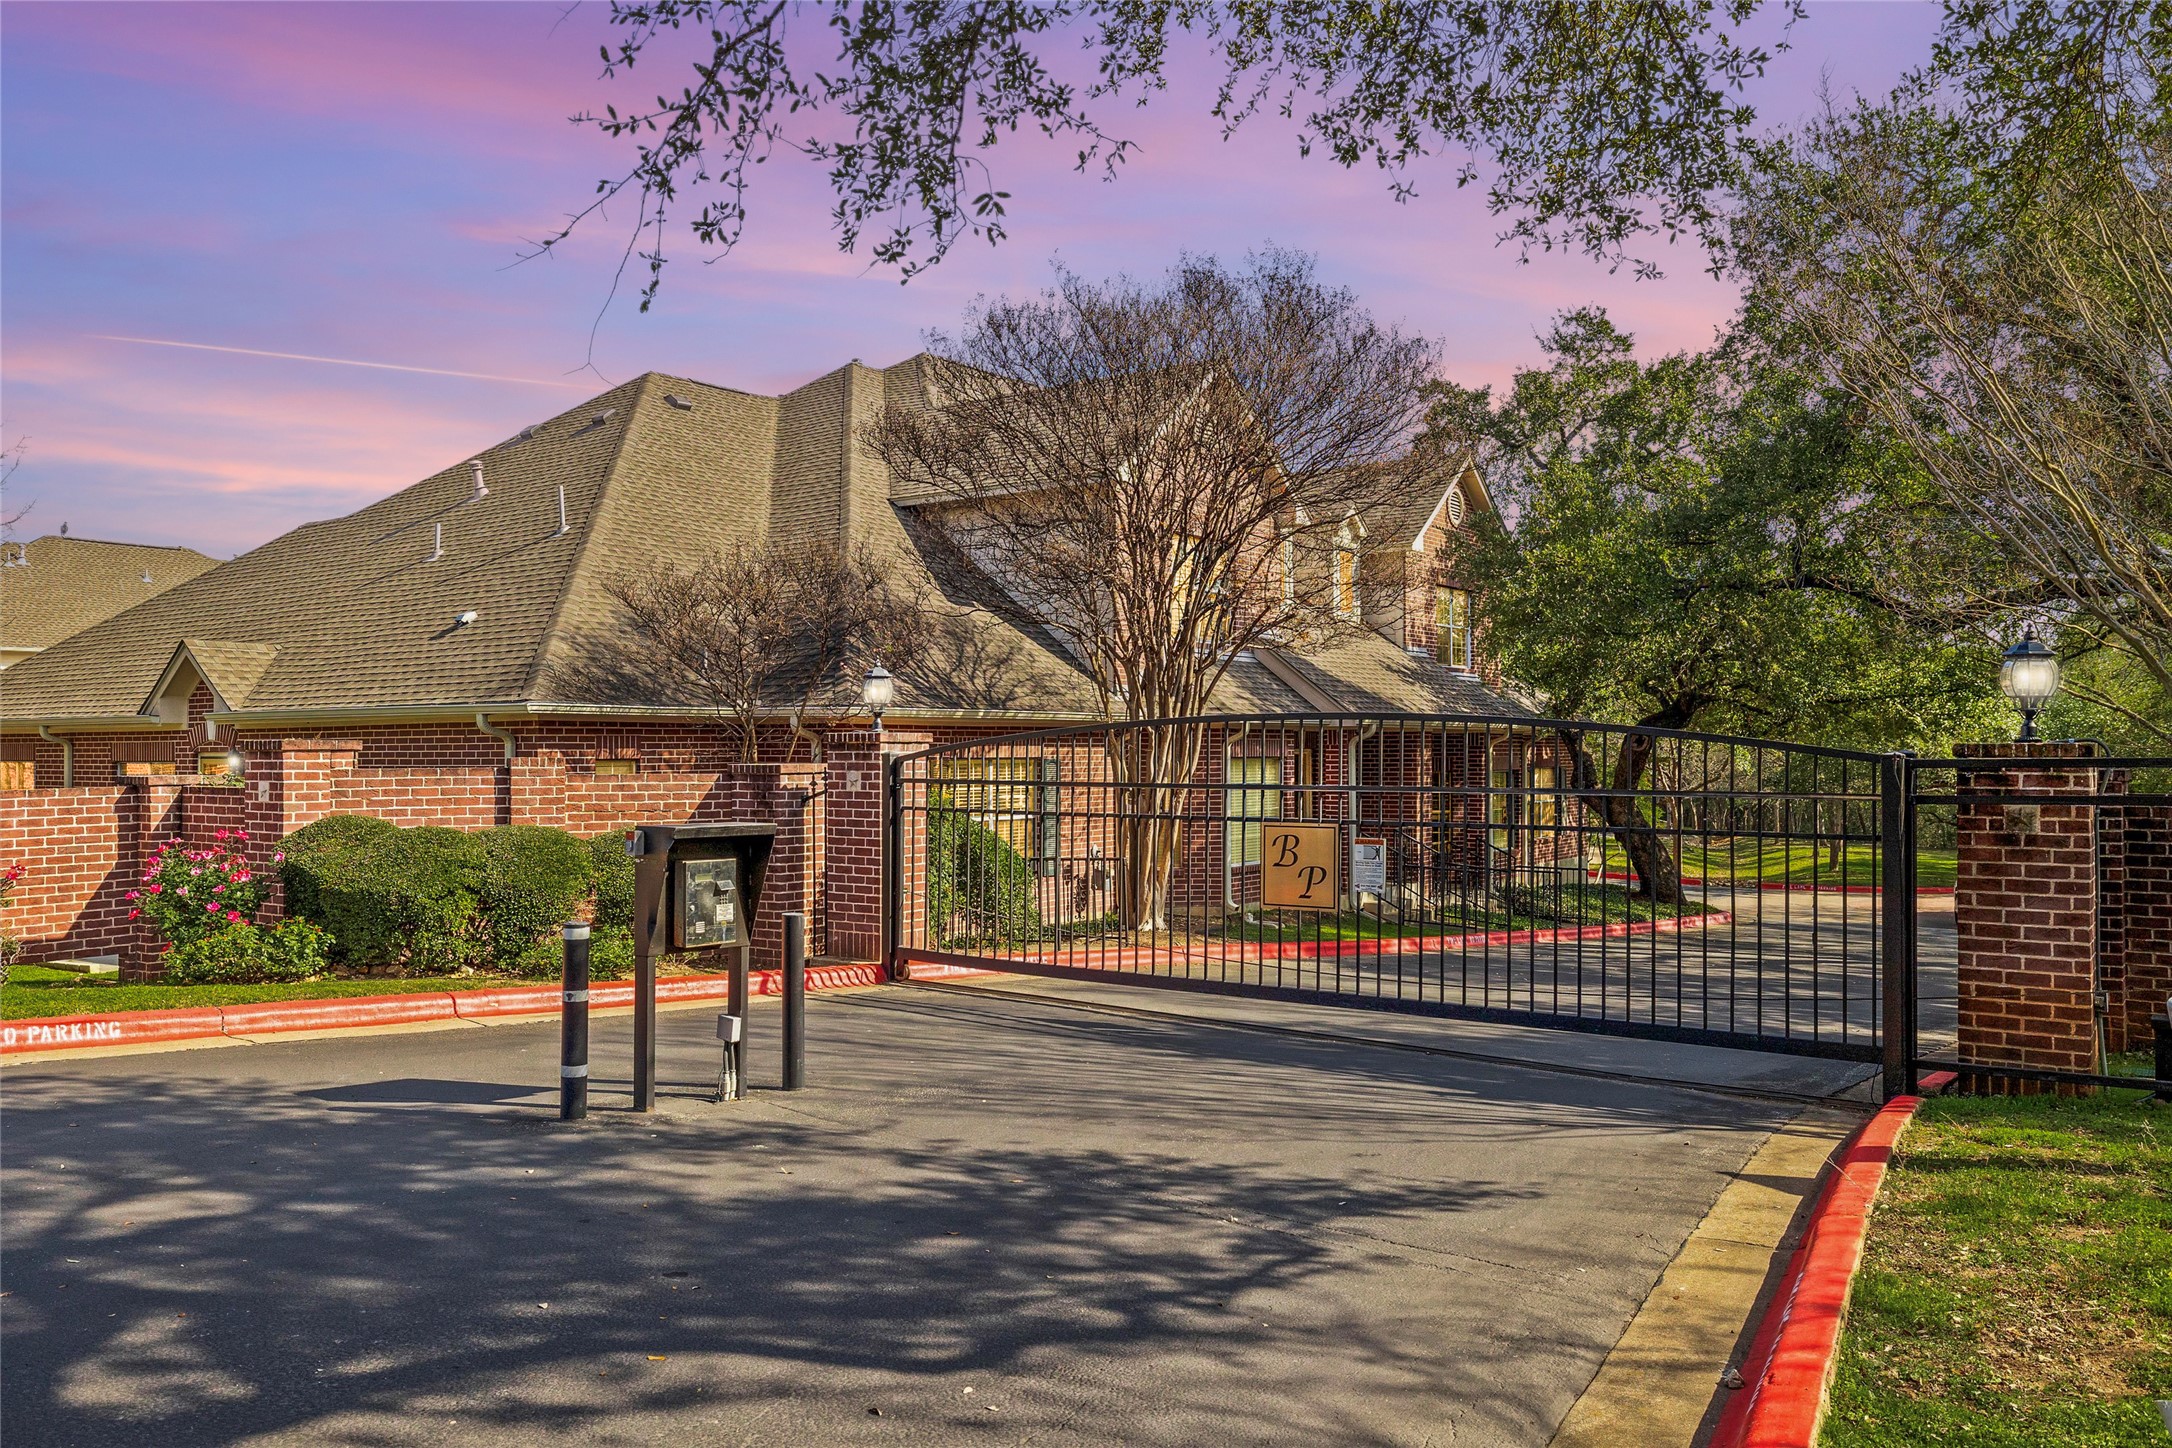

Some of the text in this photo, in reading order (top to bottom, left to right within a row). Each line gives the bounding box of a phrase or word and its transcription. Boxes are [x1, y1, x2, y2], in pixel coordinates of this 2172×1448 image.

[1272, 834, 1300, 867] B
[1297, 866, 1327, 899] P
[3, 1021, 121, 1046] O PARKING
